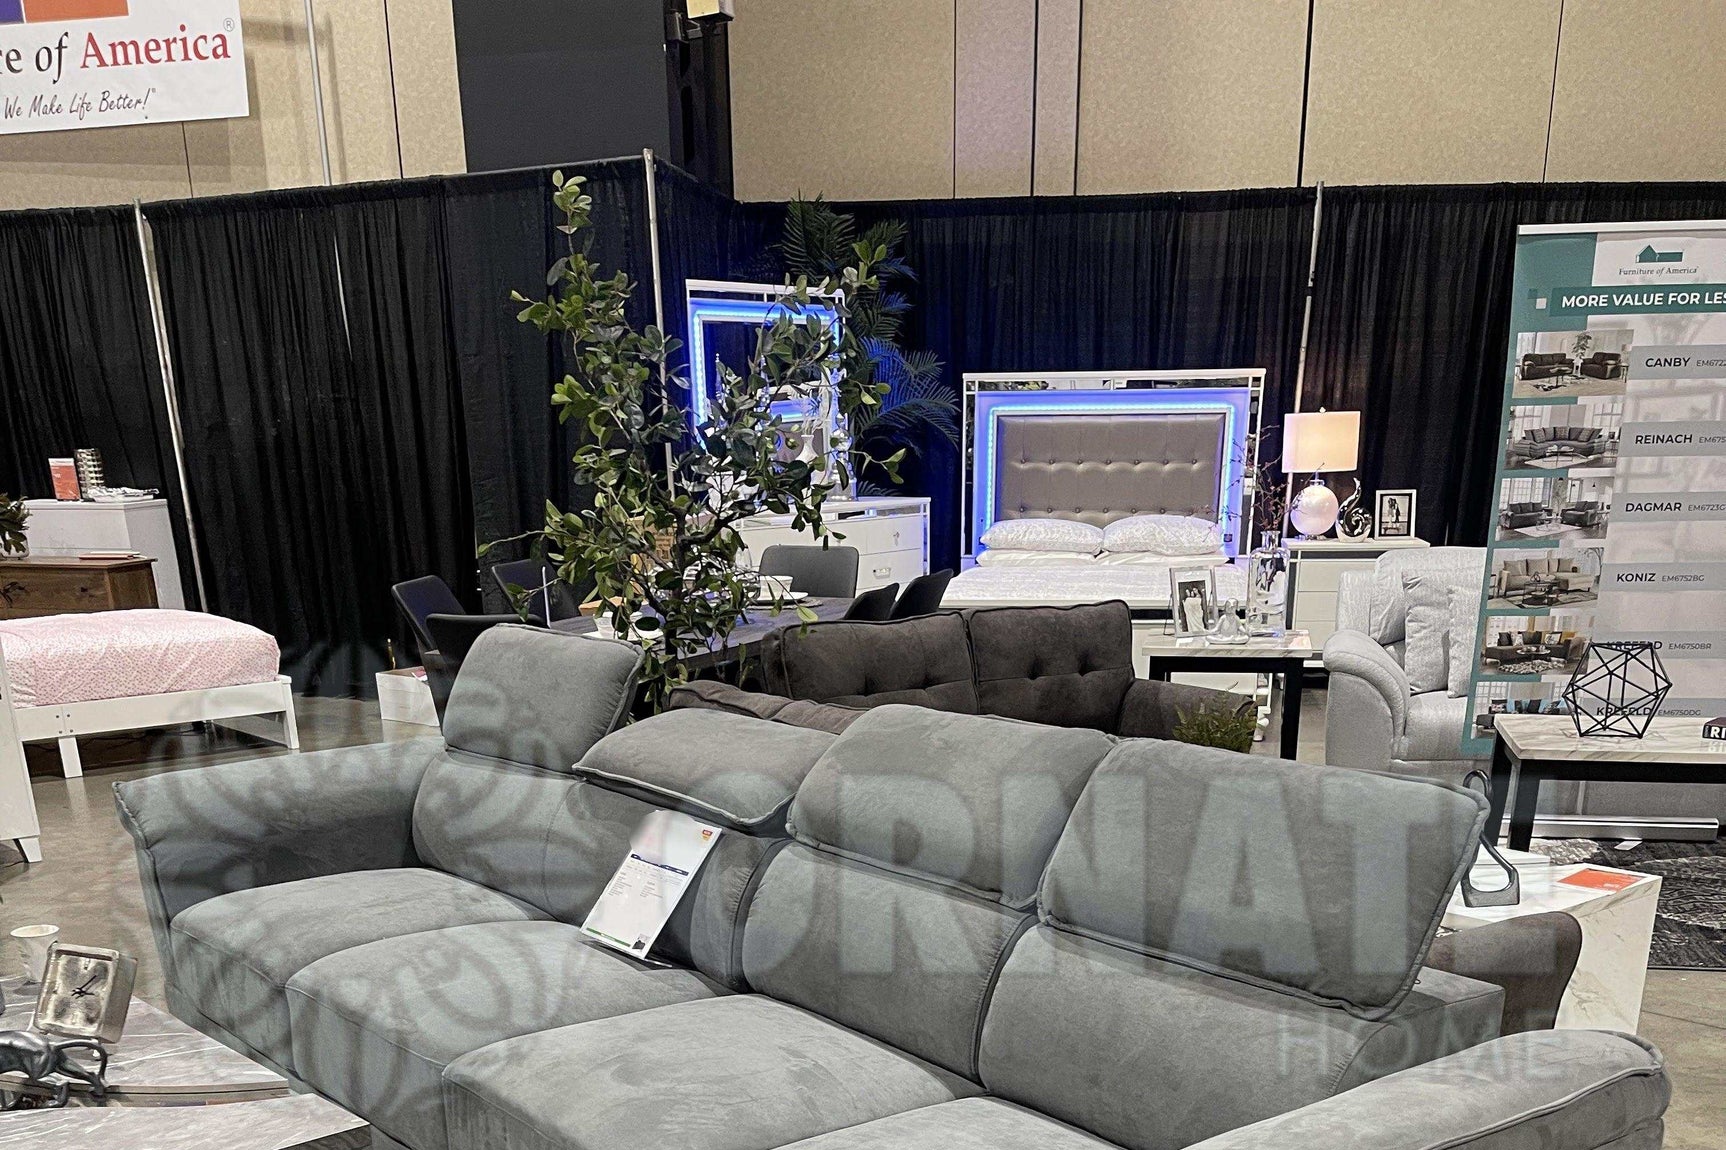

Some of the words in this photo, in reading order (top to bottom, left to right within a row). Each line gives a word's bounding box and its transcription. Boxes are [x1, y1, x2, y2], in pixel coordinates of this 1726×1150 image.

[35, 31, 69, 85] of
[4, 95, 23, 119] We
[28, 94, 63, 118] Make
[69, 92, 92, 120] Life
[1618, 267, 1654, 276] Furniture
[1656, 267, 1665, 277] of
[1562, 294, 1609, 308] MORE
[1612, 292, 1664, 306] VALUE
[1668, 292, 1700, 305] FOR
[1645, 357, 1691, 368] CANBY
[1635, 433, 1693, 445] REINACH
[1625, 502, 1682, 512] DAGMAR
[1616, 573, 1656, 582] KONIZ
